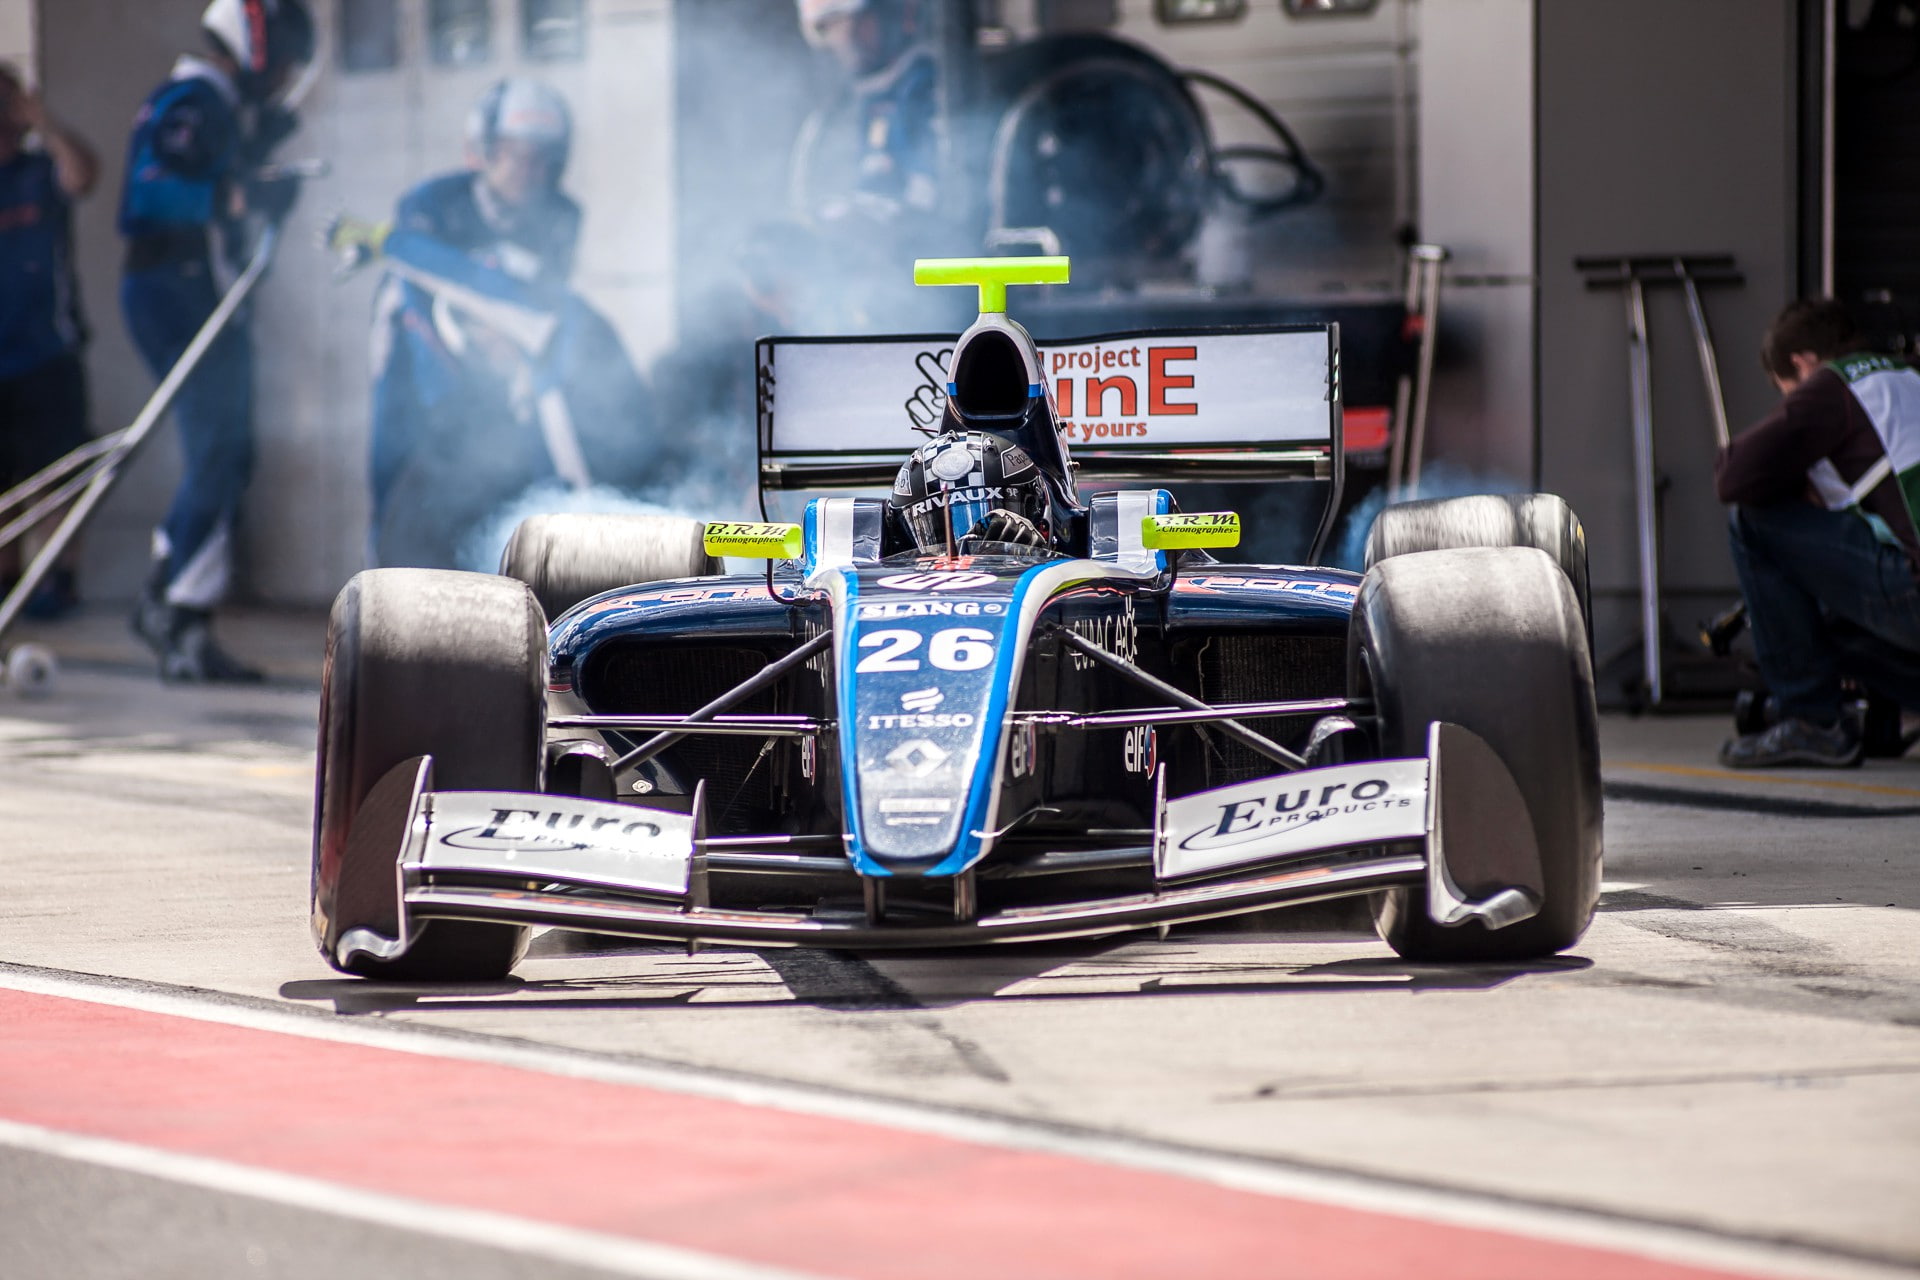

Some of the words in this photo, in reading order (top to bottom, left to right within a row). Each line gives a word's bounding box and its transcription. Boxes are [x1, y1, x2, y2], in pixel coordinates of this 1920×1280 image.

[1052, 346, 1141, 374] project
[1080, 422, 1148, 443] yours
[911, 487, 1004, 517] RIVAUX
[861, 602, 980, 617] SLANG
[855, 628, 995, 673] 26
[868, 713, 974, 730] ITESSO
[1125, 727, 1144, 772] elf
[1210, 780, 1389, 838] Euro
[1268, 798, 1411, 826] PRODUCTS
